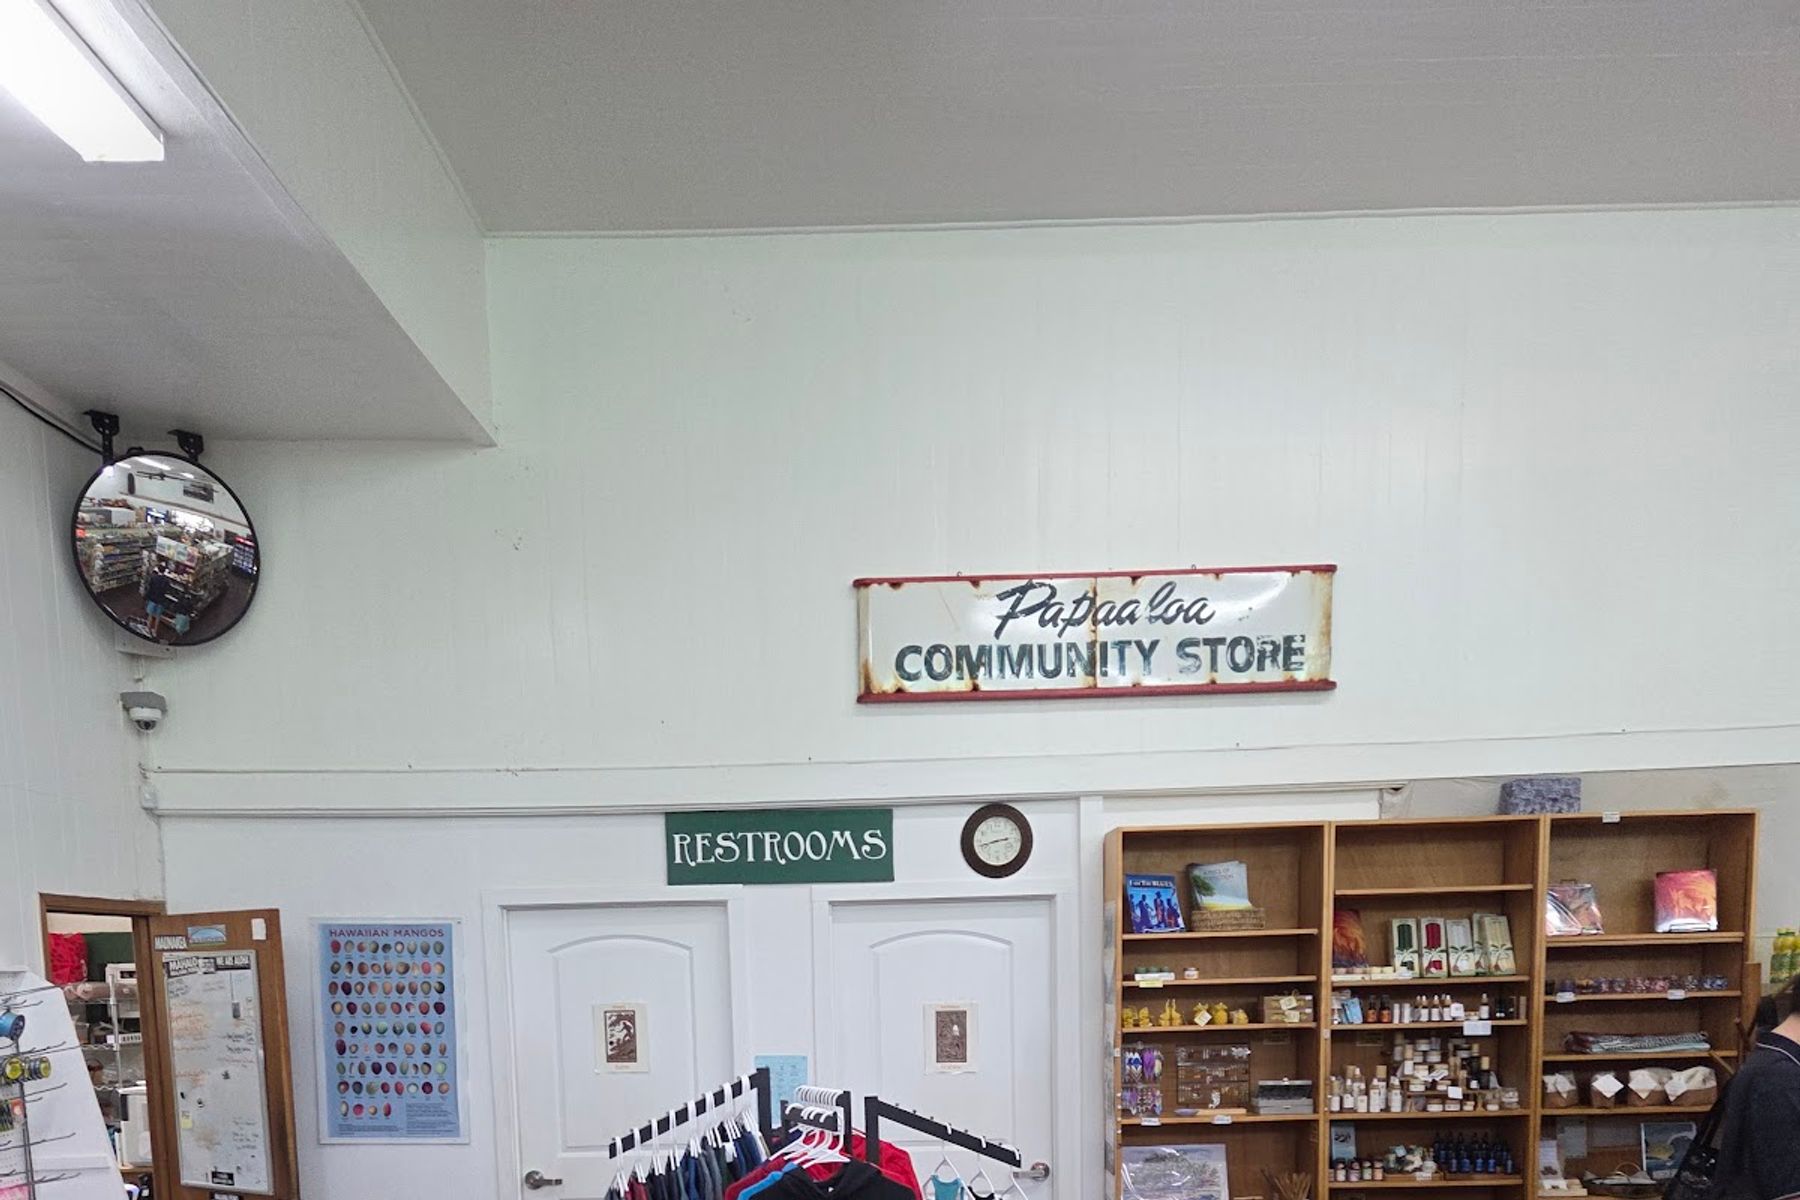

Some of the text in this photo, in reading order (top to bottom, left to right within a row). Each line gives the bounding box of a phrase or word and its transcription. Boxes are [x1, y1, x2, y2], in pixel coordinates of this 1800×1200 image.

[895, 634, 1305, 681] COMMUNITY STORE
[673, 830, 887, 867] RESTROOMS
[329, 928, 445, 938] HAWAIIAN MANGOS
